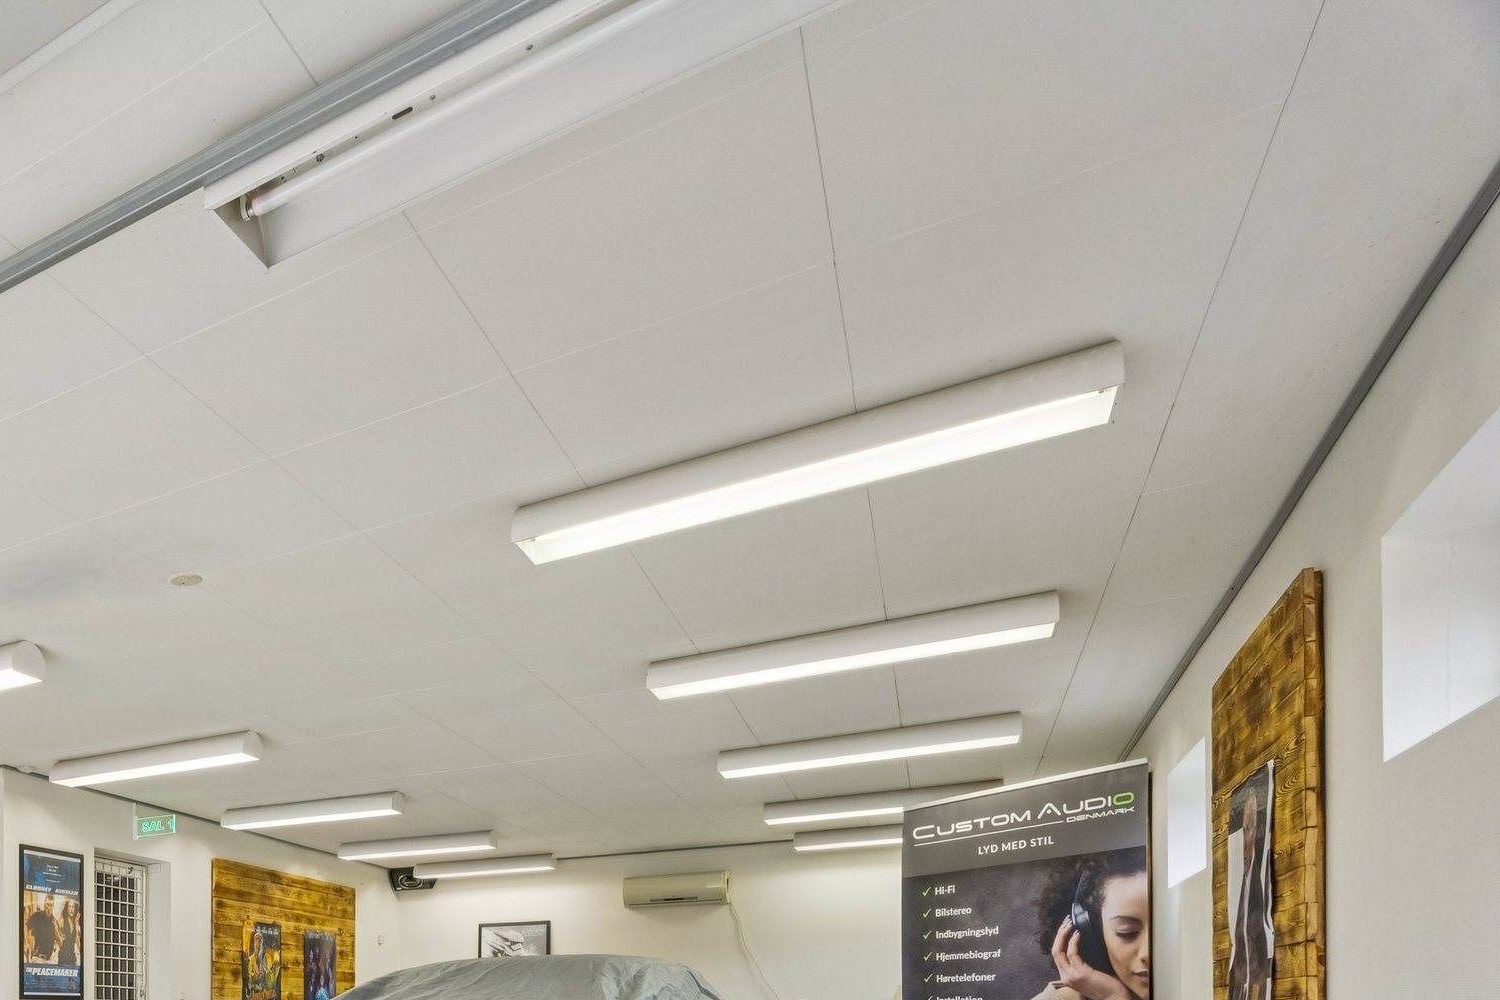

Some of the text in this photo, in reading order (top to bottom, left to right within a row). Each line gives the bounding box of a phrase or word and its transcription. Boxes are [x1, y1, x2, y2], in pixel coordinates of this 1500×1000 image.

[912, 792, 1135, 840] CUSTOM AUDIO
[1066, 806, 1135, 823] DENMARK
[142, 818, 173, 832] SAL 1
[978, 836, 1054, 855] LYD MED STIL
[934, 884, 956, 896] Hi-Fi
[935, 906, 972, 918] Bilstereo
[936, 926, 999, 940] Indbygningslyd
[936, 948, 1002, 962] Hjemmebiograf
[32, 967, 78, 977] PEACEMAKER
[936, 972, 996, 983] Høretelefoner
